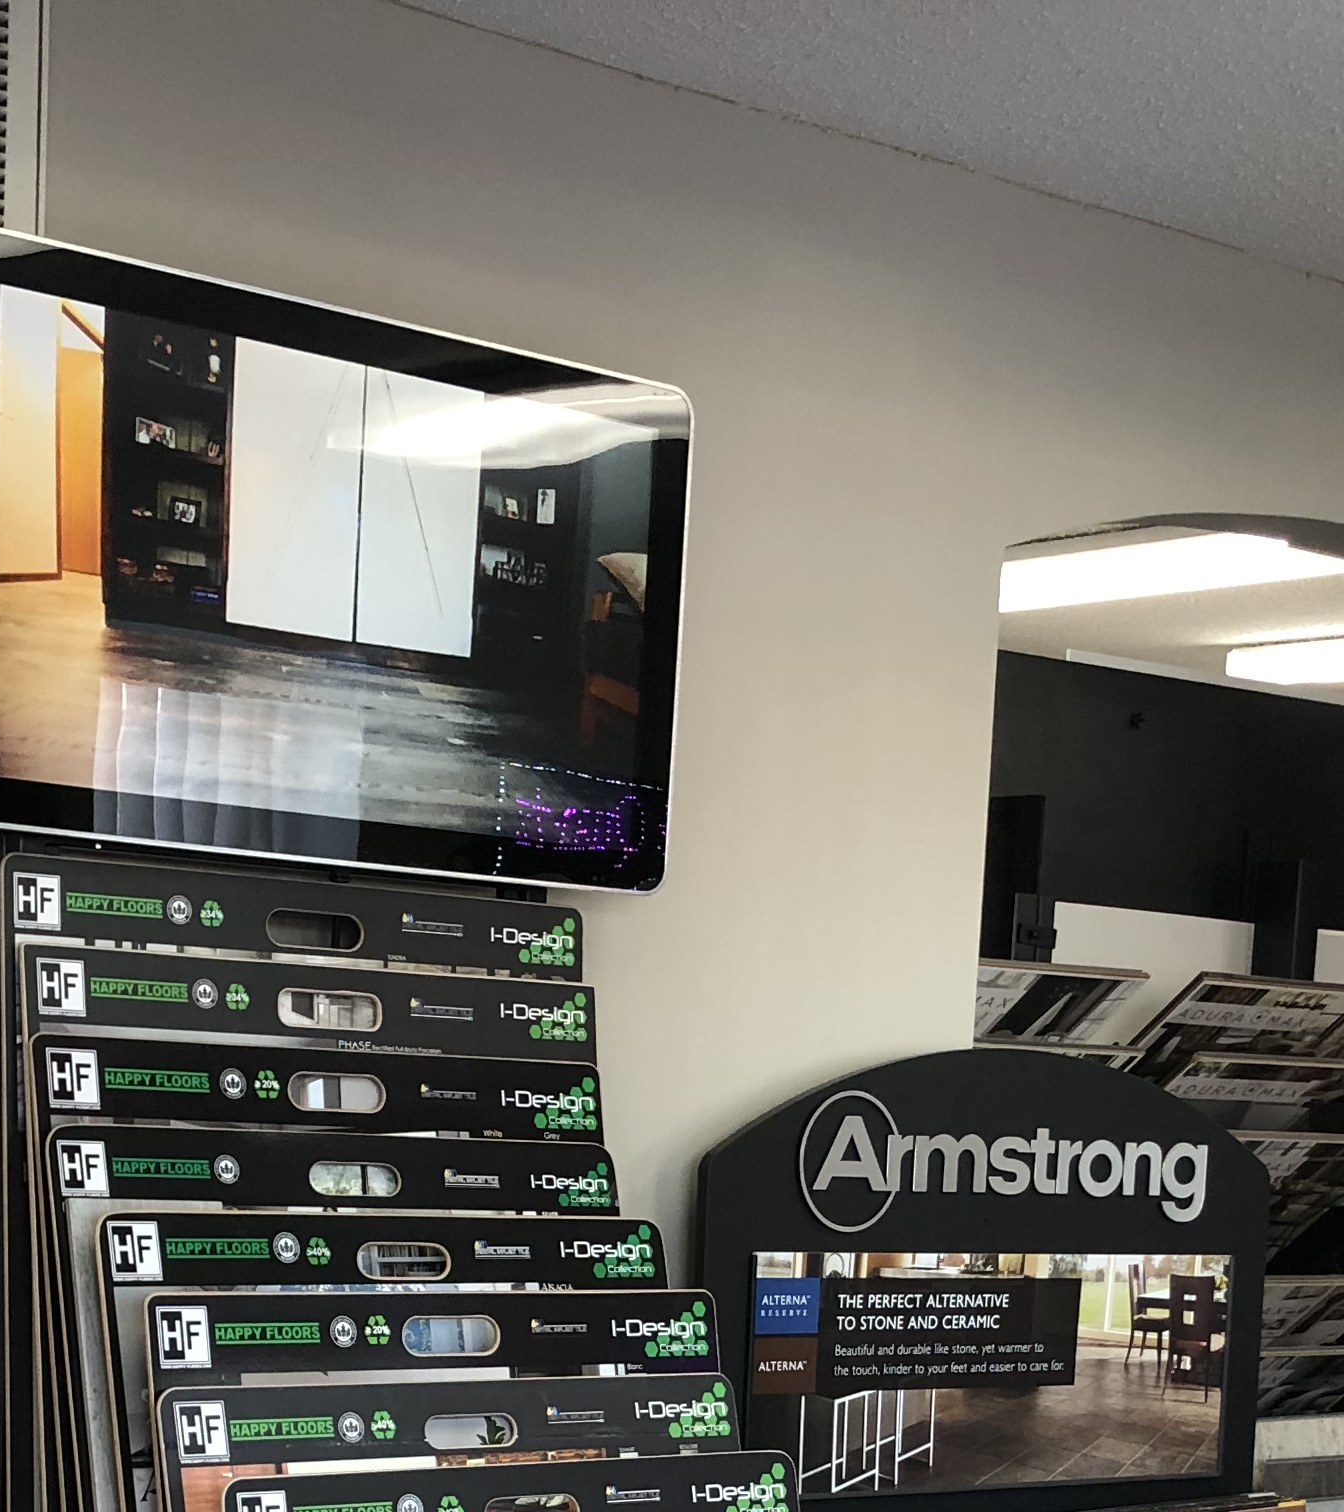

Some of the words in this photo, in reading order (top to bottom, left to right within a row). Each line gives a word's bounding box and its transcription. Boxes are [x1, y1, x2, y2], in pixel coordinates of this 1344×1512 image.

[66, 895, 110, 910] HAPPY
[112, 899, 164, 914] FLOORS
[490, 927, 574, 950] I-Design
[531, 952, 574, 963] Collection
[90, 980, 135, 995] HAPPY
[137, 984, 189, 999] FLOORS
[500, 1003, 585, 1025] I-Design
[1178, 1008, 1245, 1024] ADURA
[542, 1028, 586, 1038] Collection
[338, 1039, 372, 1051] PHASE
[105, 1070, 152, 1086] HAPPY
[155, 1073, 210, 1089] FLOORS
[1169, 1083, 1237, 1097] ADURA
[501, 1089, 595, 1113] I-Design
[548, 1115, 595, 1127] Collection
[543, 1131, 561, 1141] Grey
[112, 1160, 157, 1175] HAPPY
[160, 1162, 211, 1176] FLOORS
[812, 1114, 1210, 1224] Armstrong
[530, 1174, 607, 1193] I-Design
[570, 1195, 609, 1204] Collection
[166, 1241, 213, 1256] HAPPY
[216, 1241, 270, 1255] FLOORS
[560, 1240, 652, 1261] I-Design
[607, 1264, 653, 1274] Collection
[837, 1293, 864, 1309] THE
[867, 1293, 922, 1309] PERFECT
[925, 1293, 1010, 1309] ALTERNATIVE
[760, 1308, 808, 1317] RESERVE
[611, 1318, 706, 1339] I-Design
[836, 1315, 857, 1331] TO
[859, 1315, 905, 1331] STONE
[907, 1315, 938, 1330] AND
[942, 1314, 1001, 1330] CERAMIC
[215, 1325, 261, 1341] HAPPY
[265, 1325, 321, 1340] FLOORS
[658, 1342, 707, 1353] Collection
[834, 1343, 876, 1357] Beautiful
[877, 1343, 895, 1356] and
[897, 1343, 932, 1356] durable
[933, 1343, 950, 1355] like
[981, 1343, 996, 1357] yet
[997, 1344, 1032, 1354] warmer
[1034, 1342, 1045, 1354] to
[833, 1363, 850, 1377] the
[882, 1362, 913, 1376] kinder
[914, 1363, 925, 1375] to
[926, 1364, 949, 1378] your
[950, 1361, 968, 1374] feet
[969, 1361, 987, 1374] and
[988, 1361, 1016, 1374] easier
[1017, 1360, 1028, 1373] to
[1029, 1362, 1050, 1373] care
[634, 1400, 727, 1420] I-Design
[230, 1421, 277, 1438] HAPPY
[281, 1418, 335, 1436] FLOORS
[682, 1422, 728, 1433] Collection
[691, 1482, 786, 1504] I-Design
